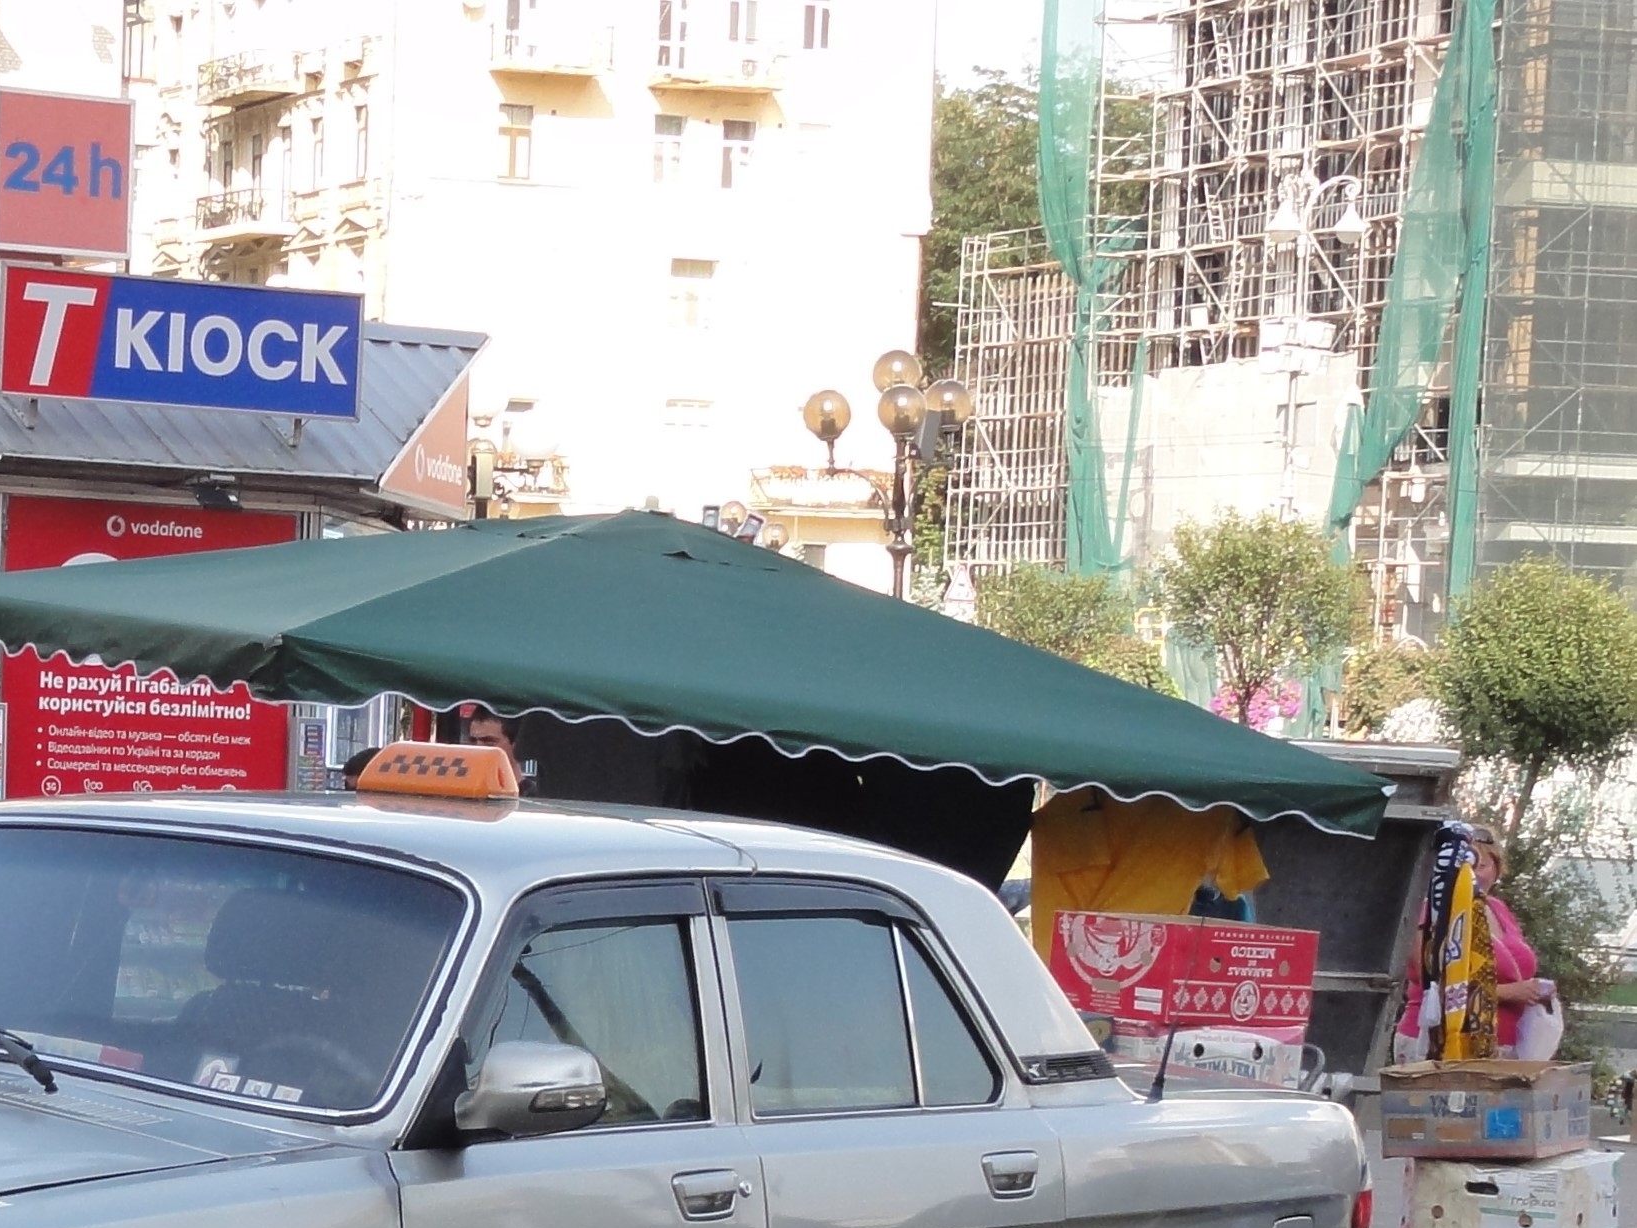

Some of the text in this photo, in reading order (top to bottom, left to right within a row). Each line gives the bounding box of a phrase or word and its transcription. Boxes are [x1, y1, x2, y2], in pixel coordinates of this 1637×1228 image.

[131, 520, 203, 539] vodafone
[40, 671, 63, 689] Не
[67, 674, 121, 695] рахуй
[39, 696, 251, 720] користуйся безлімітно!
[48, 725, 114, 739] Онлайн-відео
[117, 730, 126, 739] та
[128, 731, 162, 742] музика
[213, 733, 229, 744] без
[231, 736, 251, 745] меж
[113, 746, 125, 755] по
[127, 745, 160, 758] Україні
[162, 749, 171, 758] та
[173, 750, 184, 758] за
[186, 750, 220, 761] кордон
[102, 763, 112, 771] та
[180, 764, 197, 775] без
[1231, 946, 1276, 960] MEXICO
